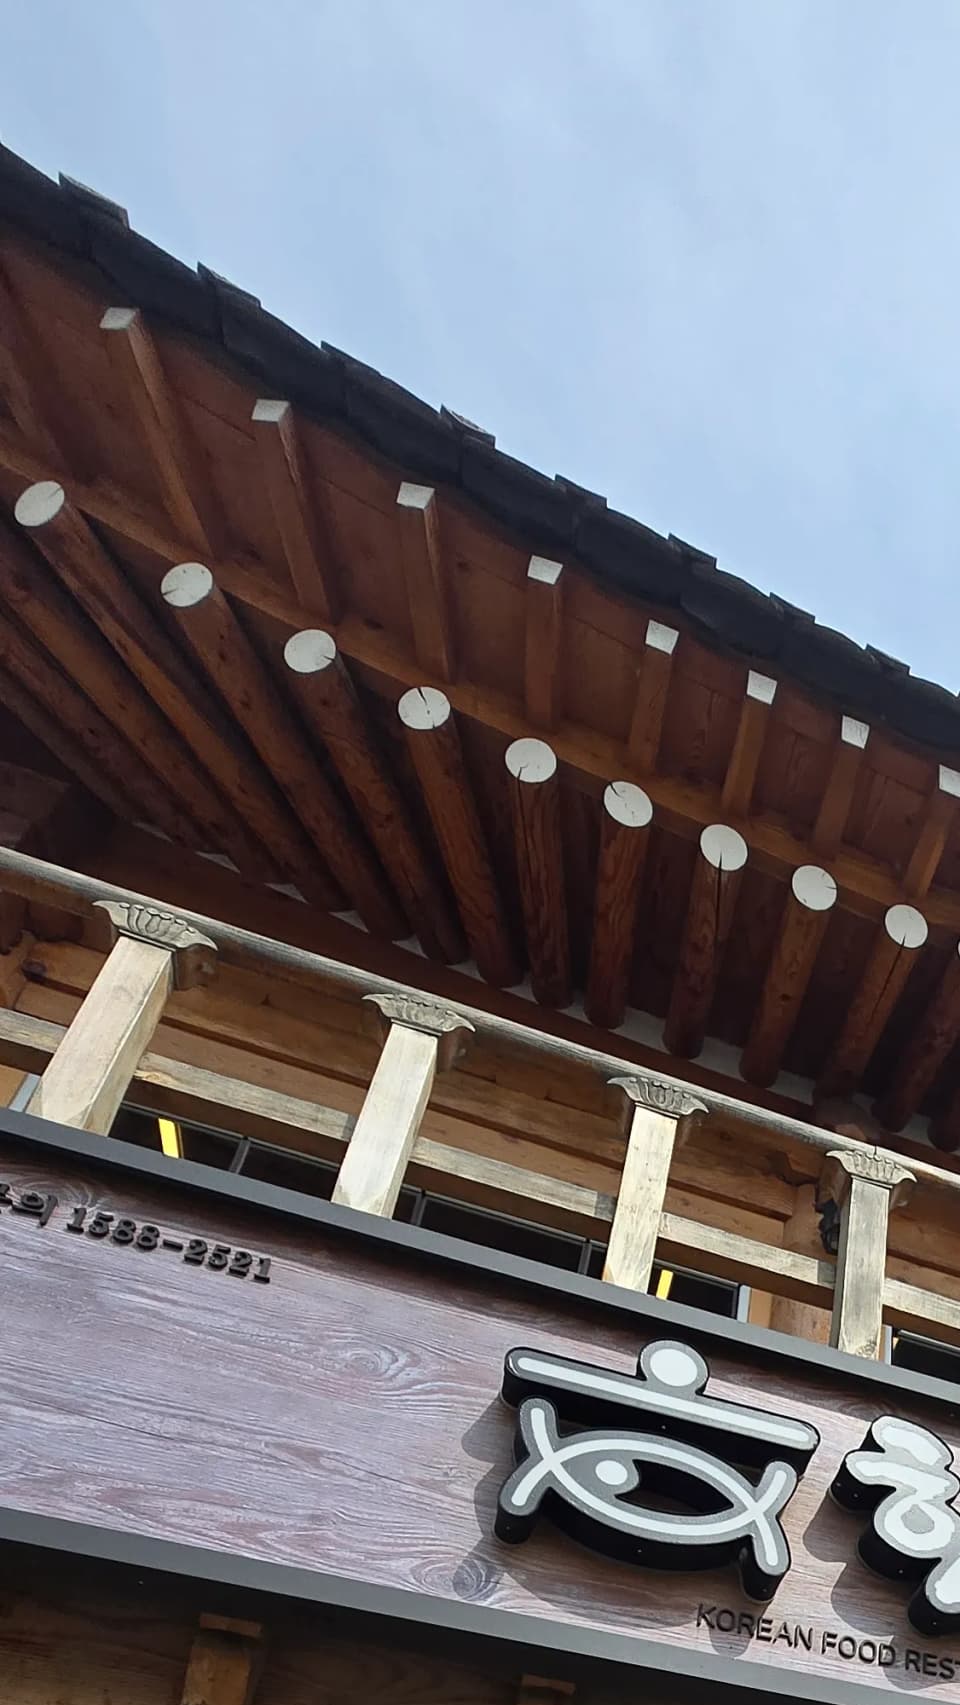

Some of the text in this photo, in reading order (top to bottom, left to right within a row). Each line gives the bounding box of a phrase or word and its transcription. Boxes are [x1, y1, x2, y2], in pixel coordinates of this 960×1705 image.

[0, 1183, 272, 1284] 의 1588-2521
[695, 1603, 814, 1652] KOREAN
[820, 1631, 896, 1667] FOOD
